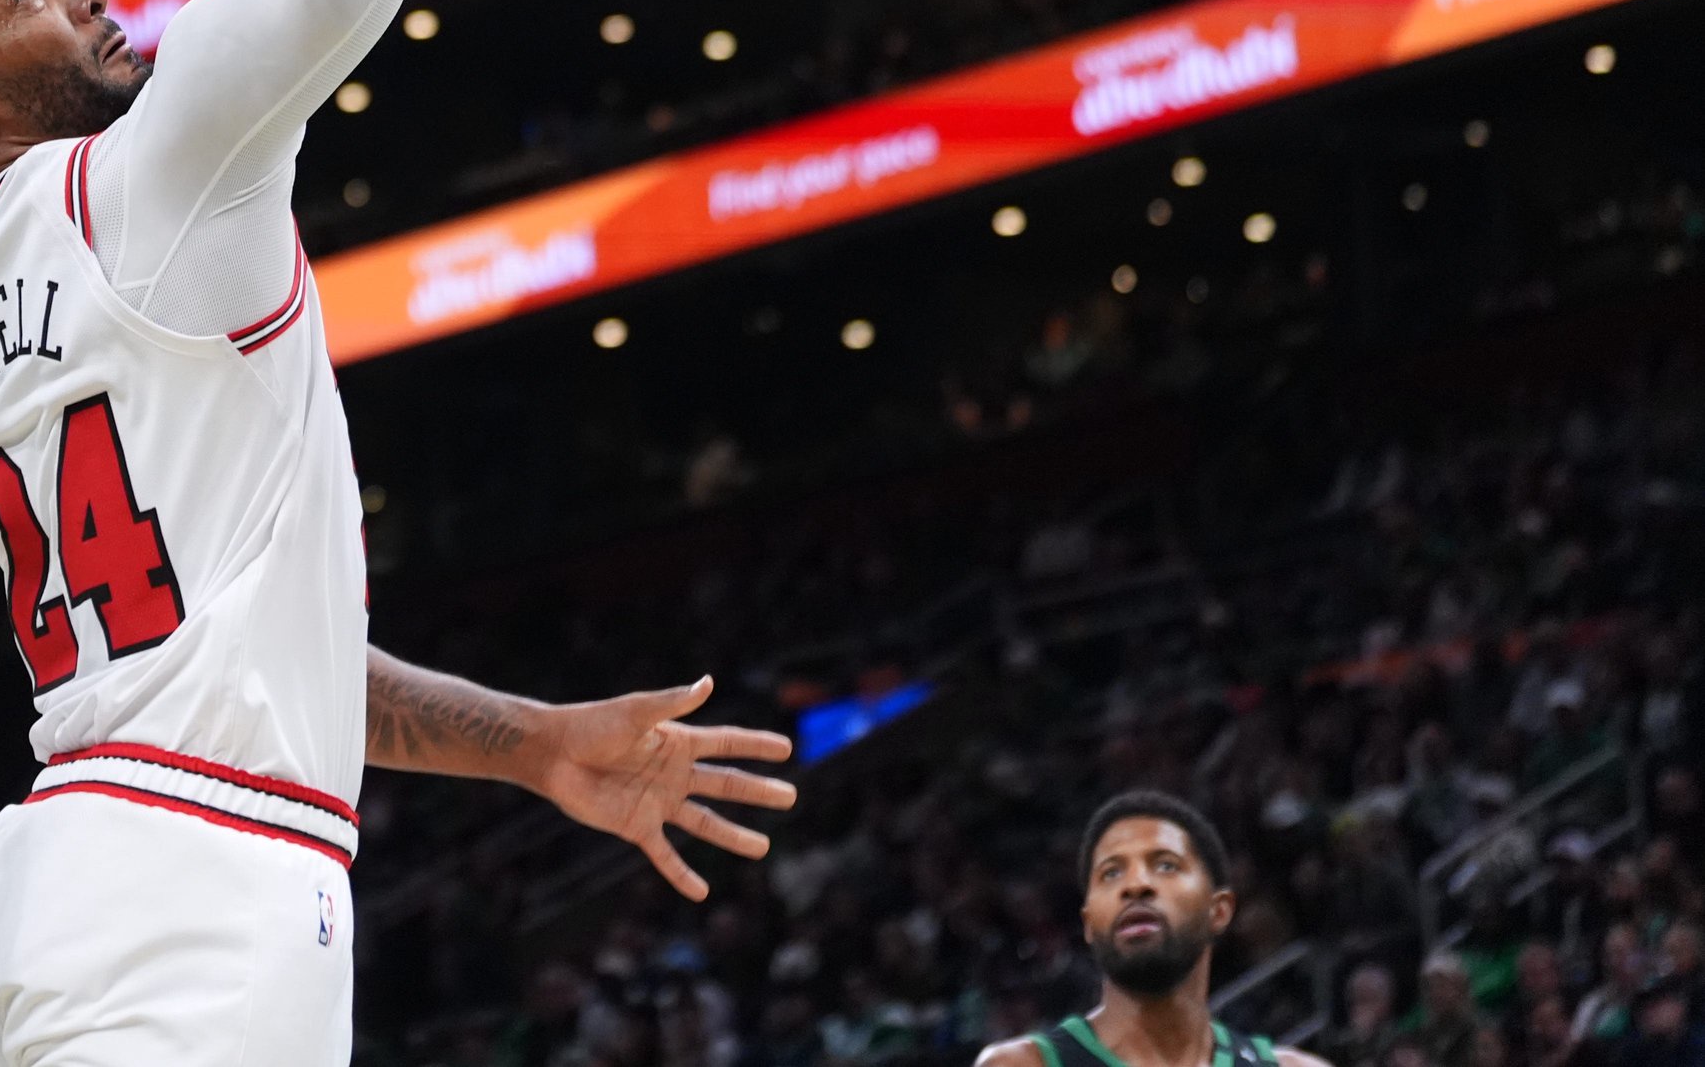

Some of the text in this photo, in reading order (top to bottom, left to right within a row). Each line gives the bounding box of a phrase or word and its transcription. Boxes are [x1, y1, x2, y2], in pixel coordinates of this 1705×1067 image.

[708, 122, 941, 224] Find your pace
